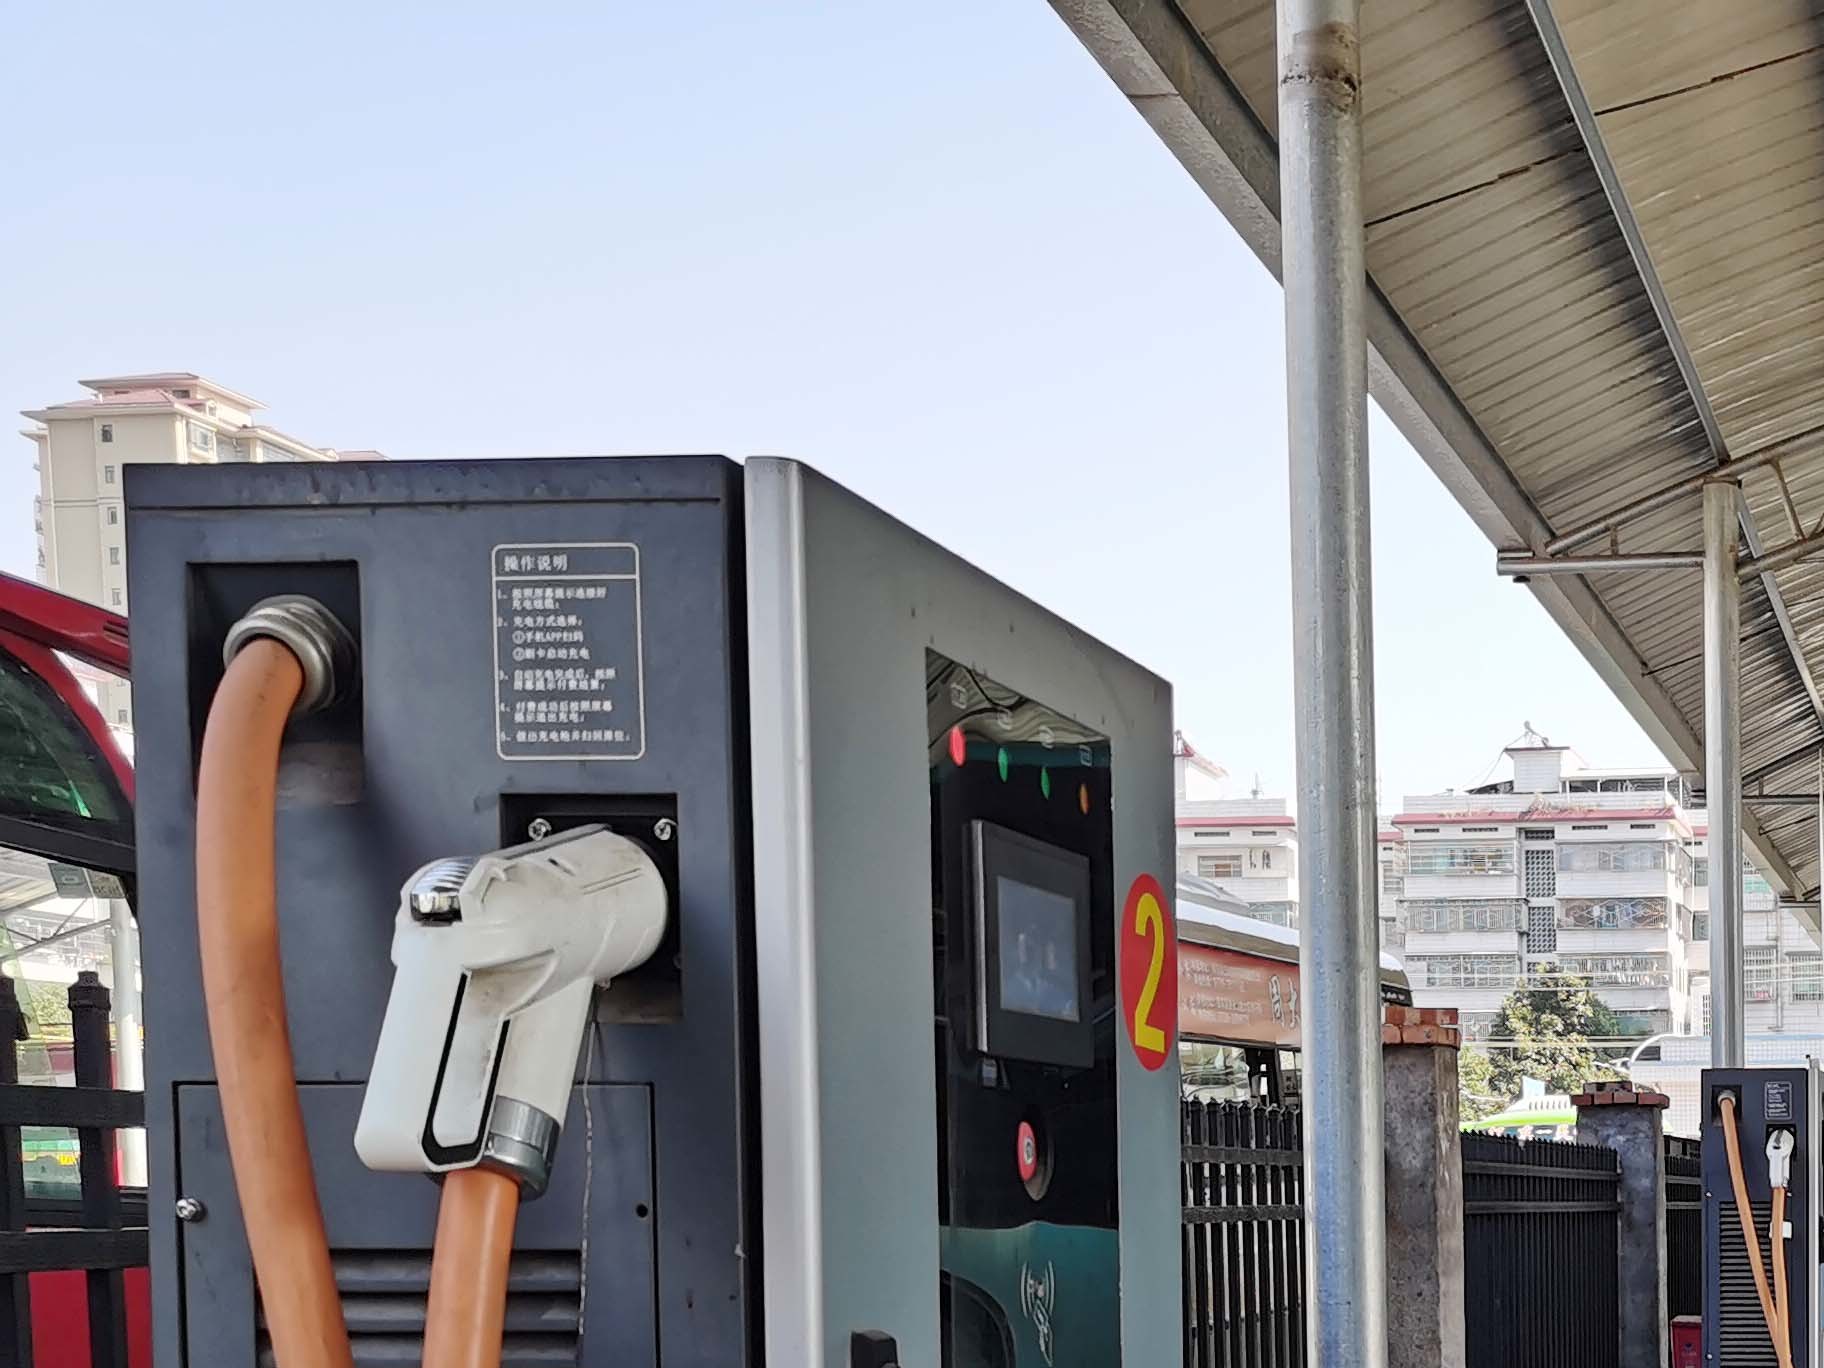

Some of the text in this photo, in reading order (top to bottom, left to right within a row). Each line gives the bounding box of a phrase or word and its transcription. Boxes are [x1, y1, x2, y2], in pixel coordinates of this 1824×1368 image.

[504, 554, 567, 572] 操作说明
[1135, 892, 1166, 1054] 2
